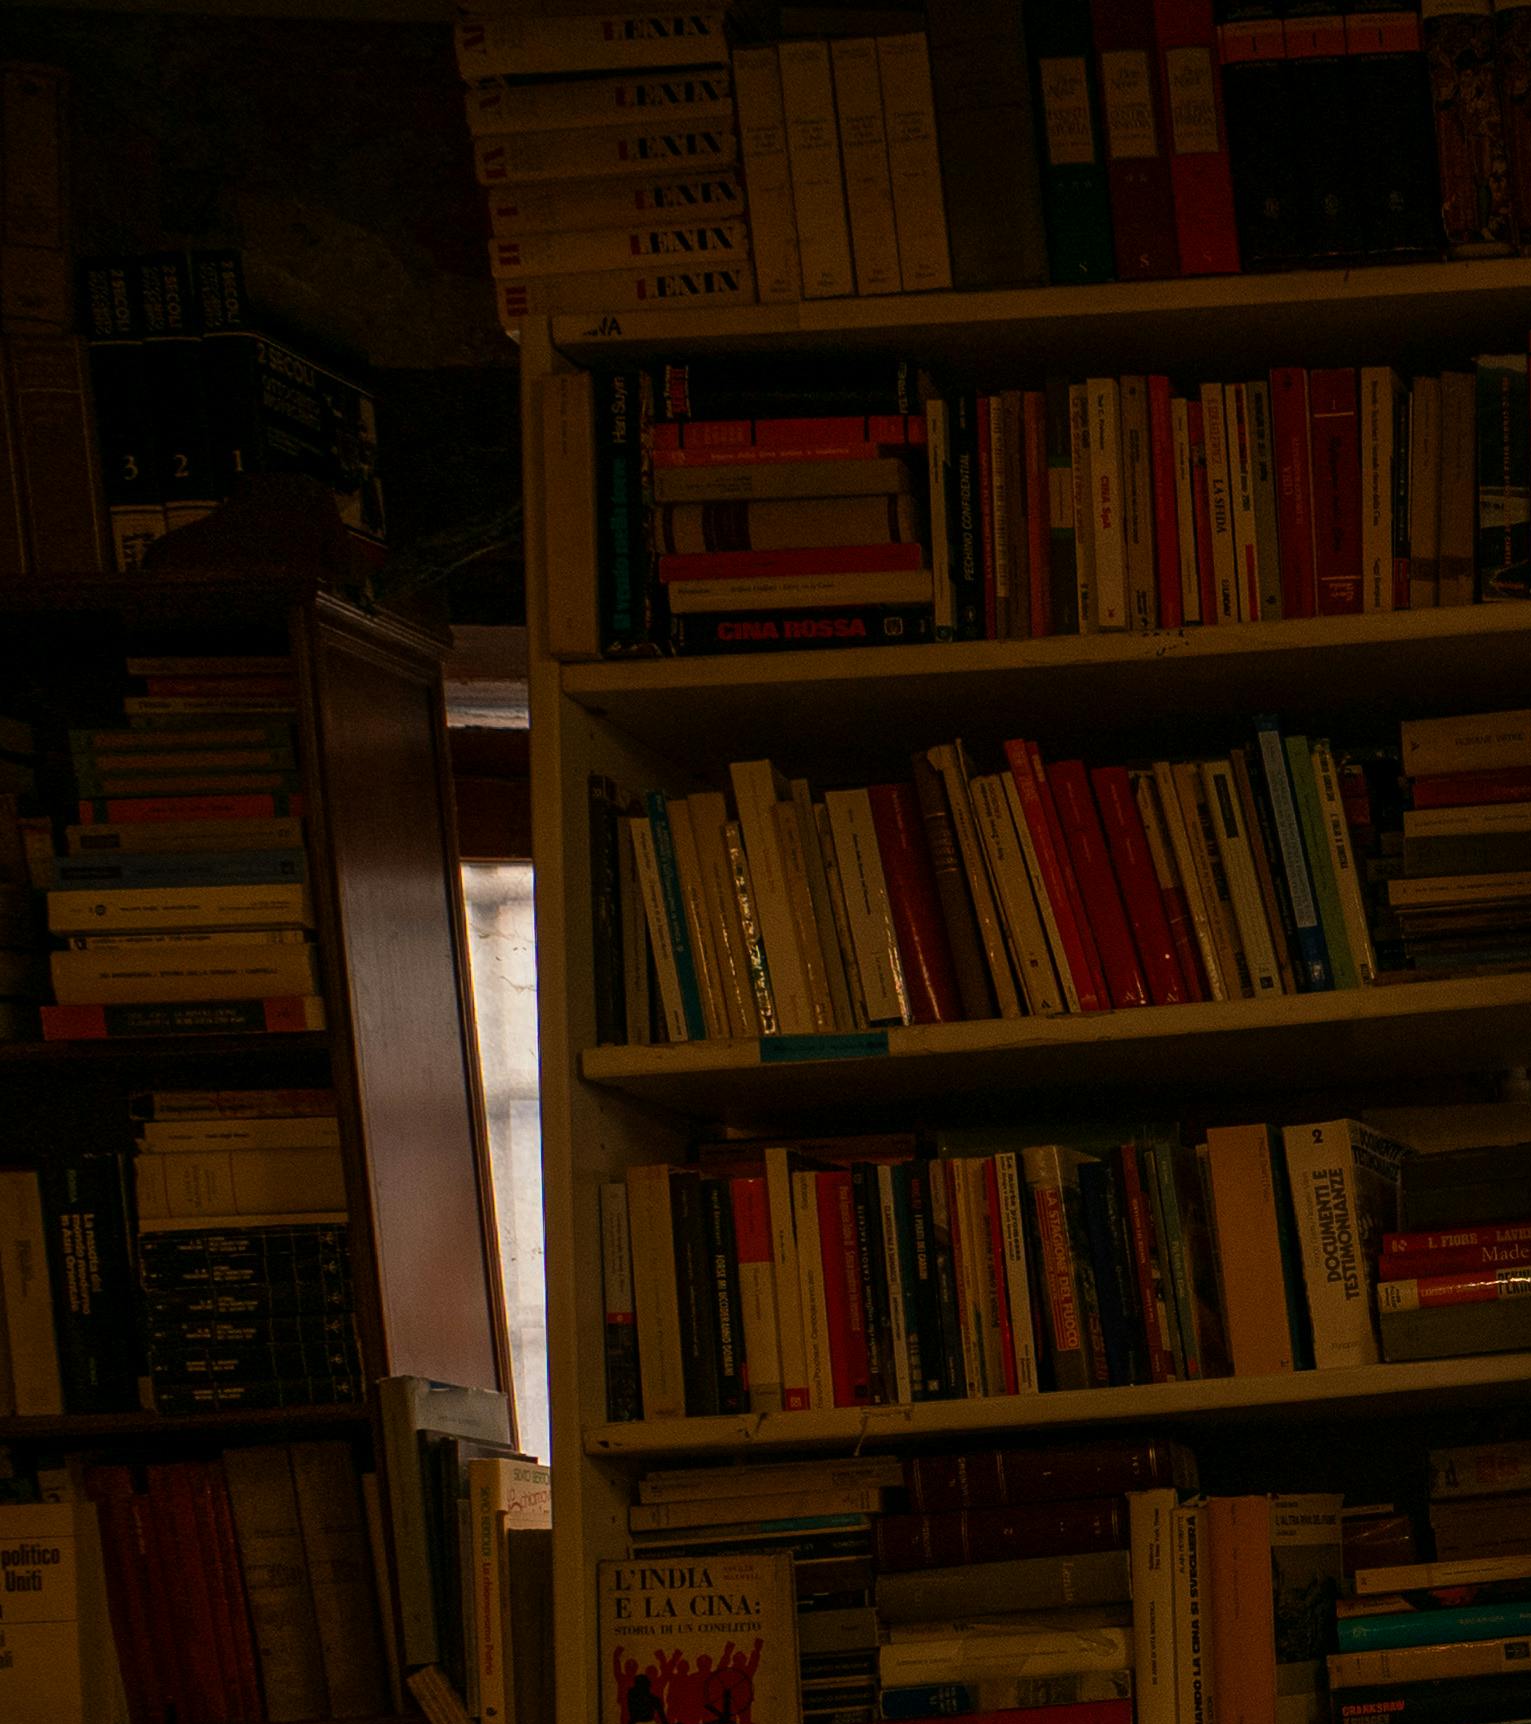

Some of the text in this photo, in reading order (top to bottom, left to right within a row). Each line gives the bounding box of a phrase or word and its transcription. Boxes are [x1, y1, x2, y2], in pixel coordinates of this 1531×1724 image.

[717, 617, 867, 644] CINA ROSSA
[1312, 1129, 1324, 1143] 2
[1313, 1171, 1341, 1283] DOCUMENTI E
[1328, 1169, 1359, 1300] TESTIMONIANZE
[1481, 1244, 1530, 1264] Made
[1, 1546, 60, 1570] politico
[5, 1571, 42, 1592] Uniti
[614, 1567, 714, 1591] L'INDIA
[614, 1596, 633, 1619] E
[644, 1596, 678, 1619] LA
